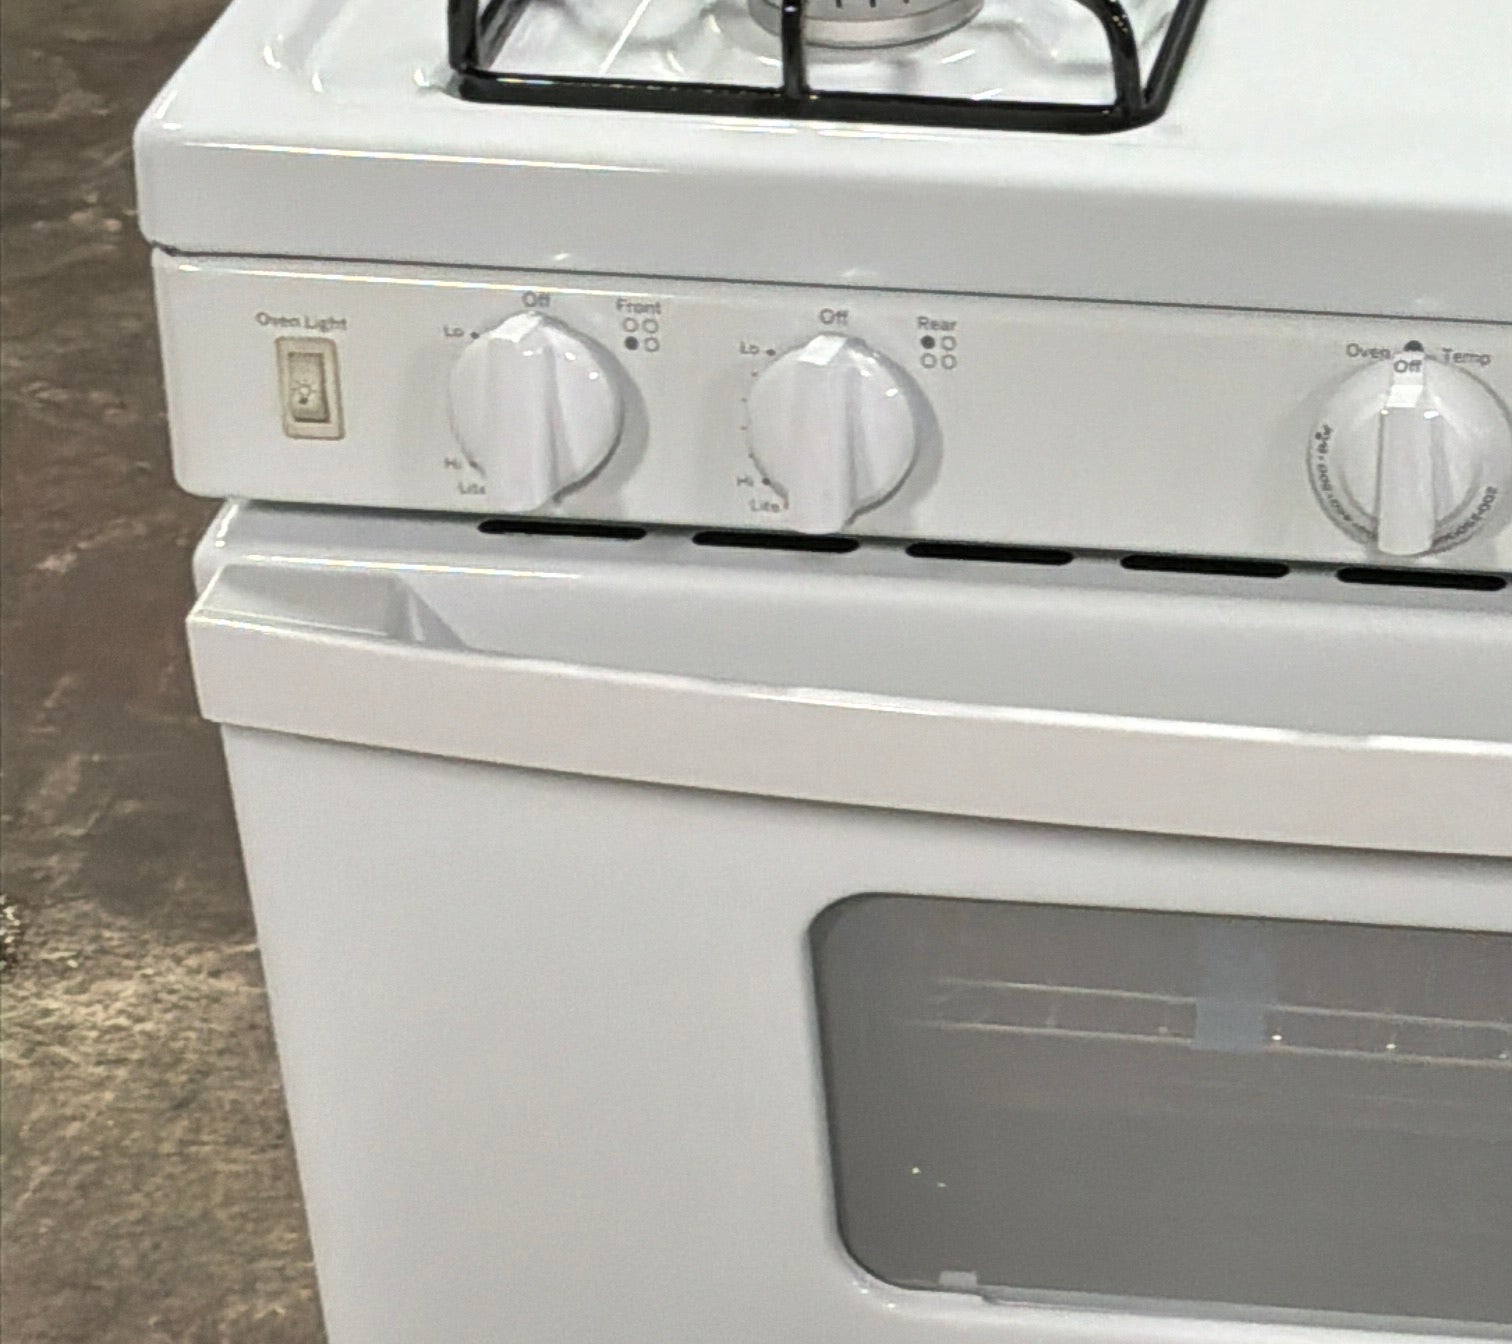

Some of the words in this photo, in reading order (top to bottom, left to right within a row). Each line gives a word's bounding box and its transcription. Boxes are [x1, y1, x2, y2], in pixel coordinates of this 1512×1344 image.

[522, 290, 550, 308] Off
[616, 298, 662, 314] Front
[819, 308, 849, 326] Off
[917, 316, 958, 331] Rear
[443, 326, 464, 338] Lo
[740, 341, 760, 355] Lo
[1346, 343, 1392, 359] Oven
[1442, 347, 1492, 367] Temp
[1393, 359, 1422, 373] Off
